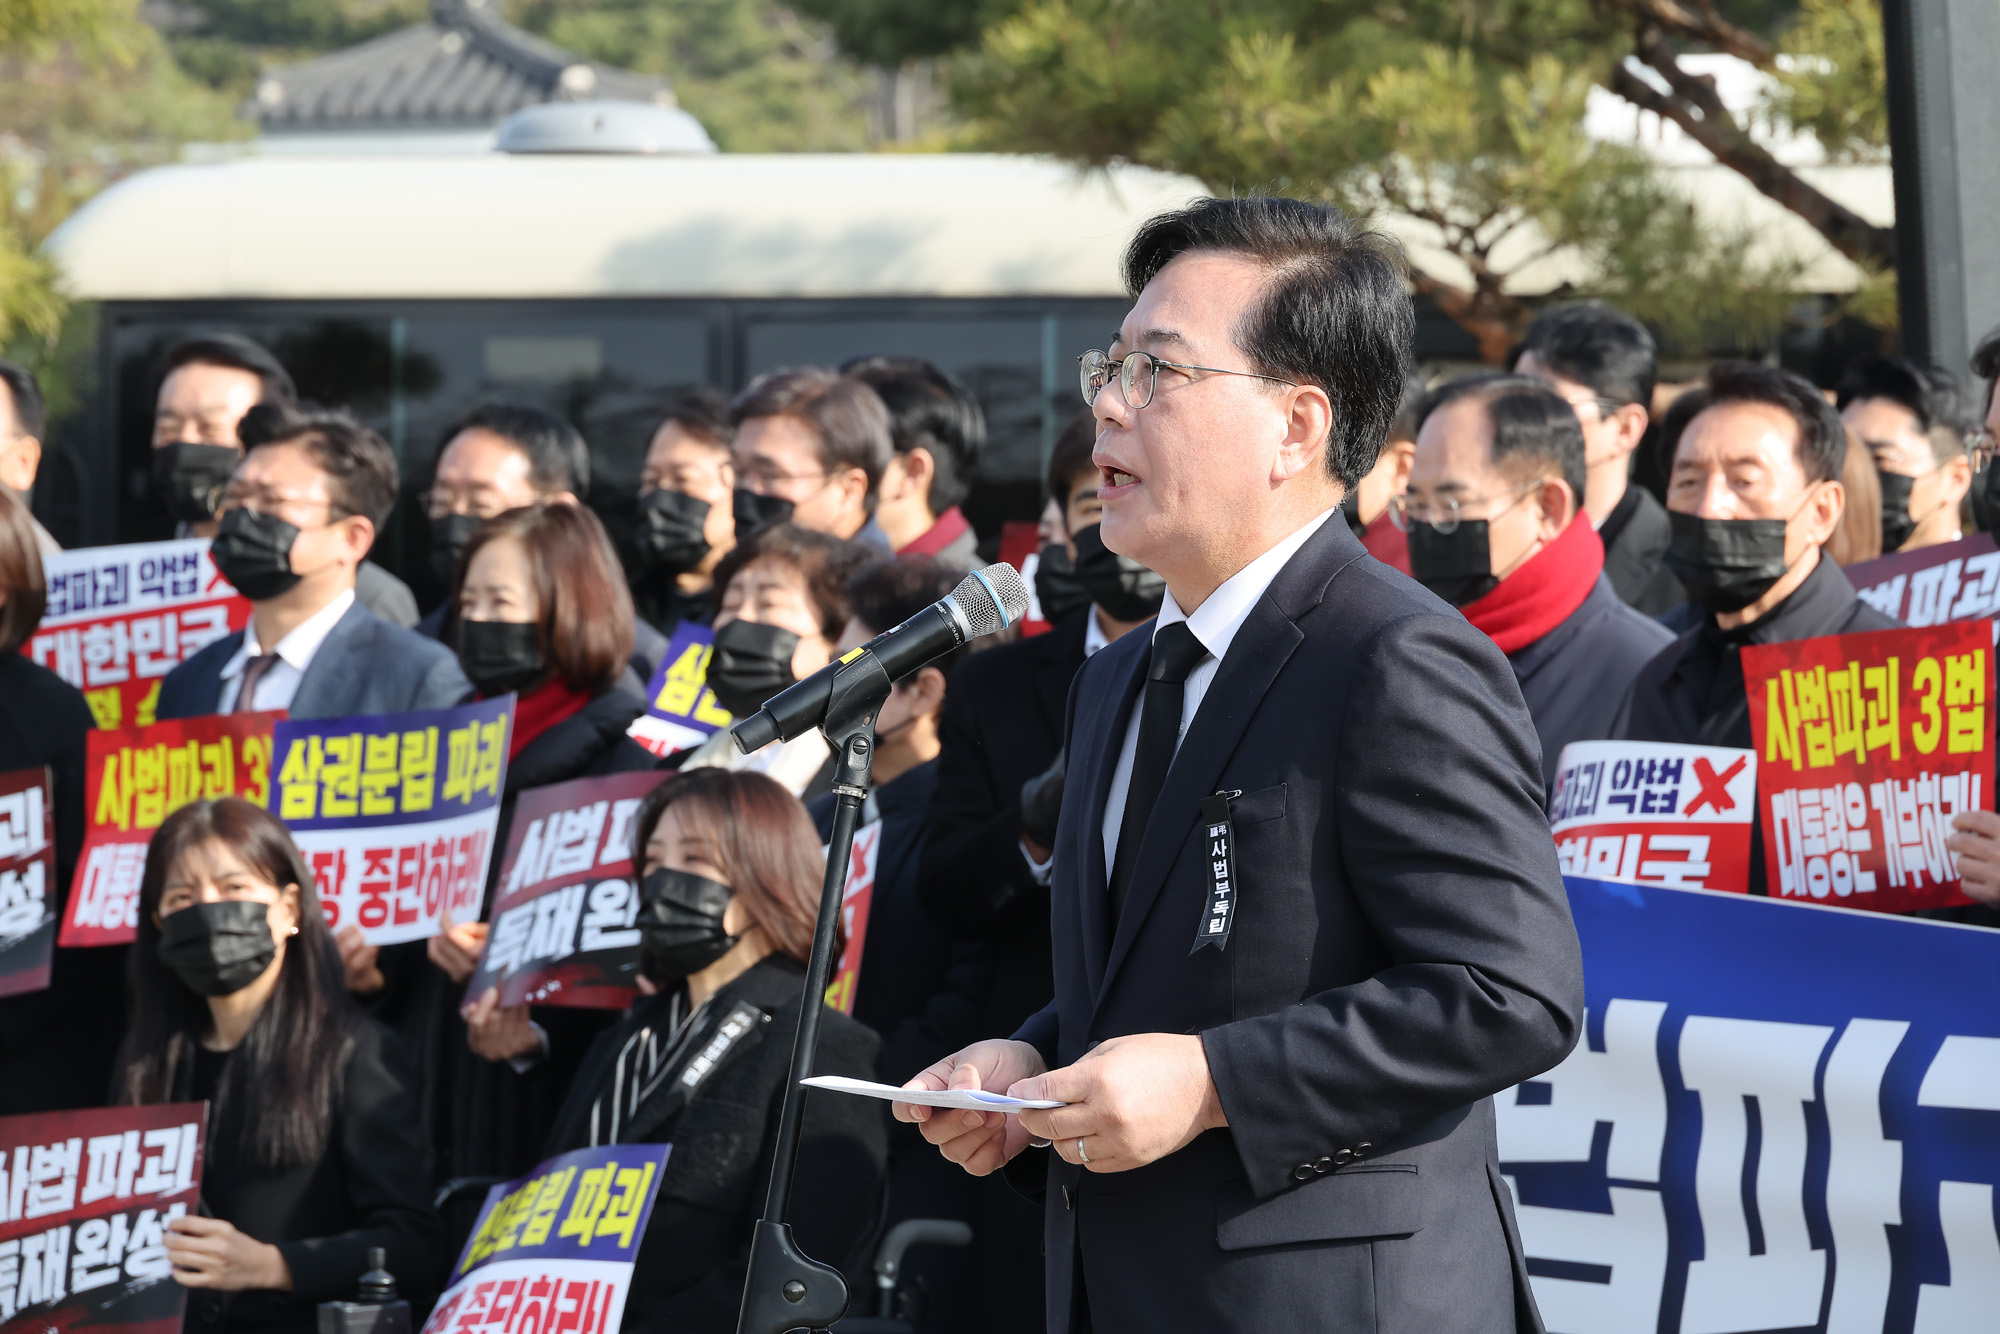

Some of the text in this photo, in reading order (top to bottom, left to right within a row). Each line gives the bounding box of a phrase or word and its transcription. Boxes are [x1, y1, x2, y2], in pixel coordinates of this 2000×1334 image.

[140, 552, 198, 599] 악법
[1766, 648, 1985, 771] 사법파괴 3법
[279, 713, 508, 821] 삼권분립 파괴
[1607, 758, 1684, 814] 악법
[506, 801, 609, 895] 사법
[1771, 782, 1877, 898] 대통령은
[75, 842, 149, 930] 대통
[1208, 838, 1231, 934] 사법부독립
[81, 1123, 199, 1205] 파괴
[557, 1161, 667, 1249] 파괴
